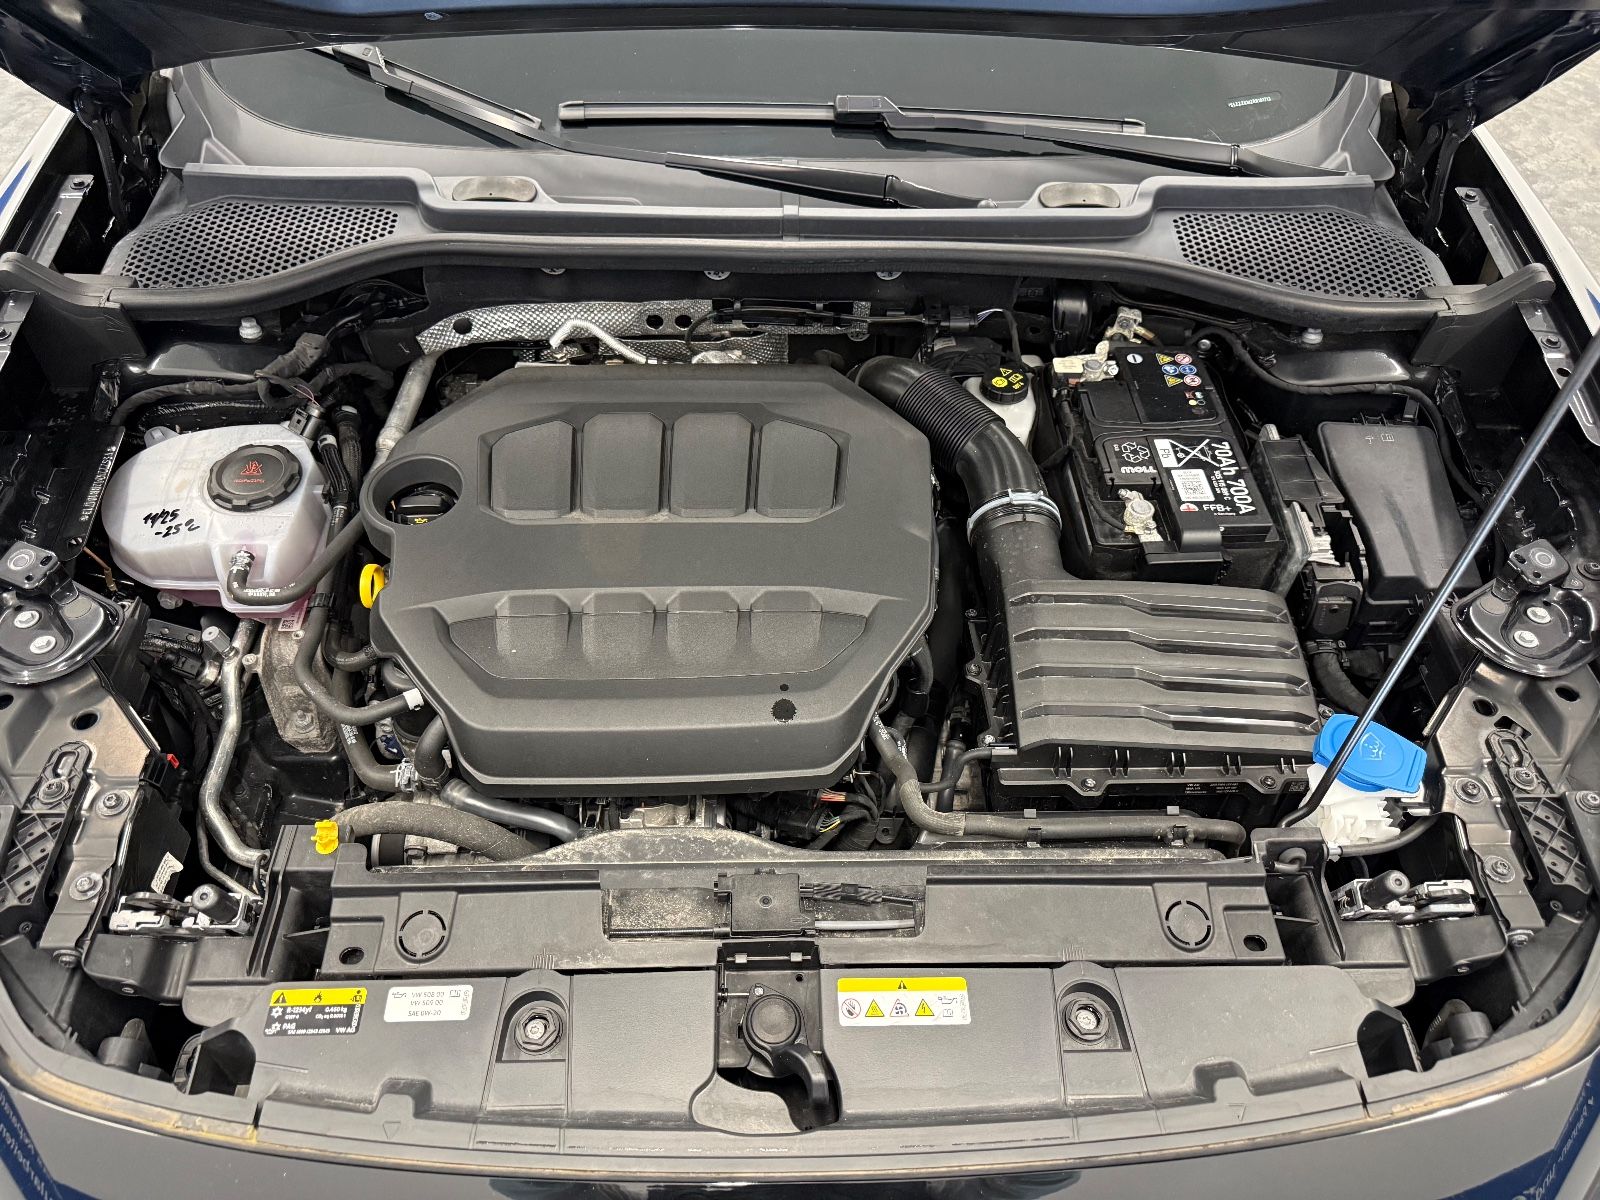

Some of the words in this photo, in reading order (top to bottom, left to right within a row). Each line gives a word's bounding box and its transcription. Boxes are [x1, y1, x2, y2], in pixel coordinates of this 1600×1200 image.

[1159, 448, 1172, 459] Pb
[1211, 441, 1239, 476] 70Ah
[1227, 479, 1256, 515] 700A
